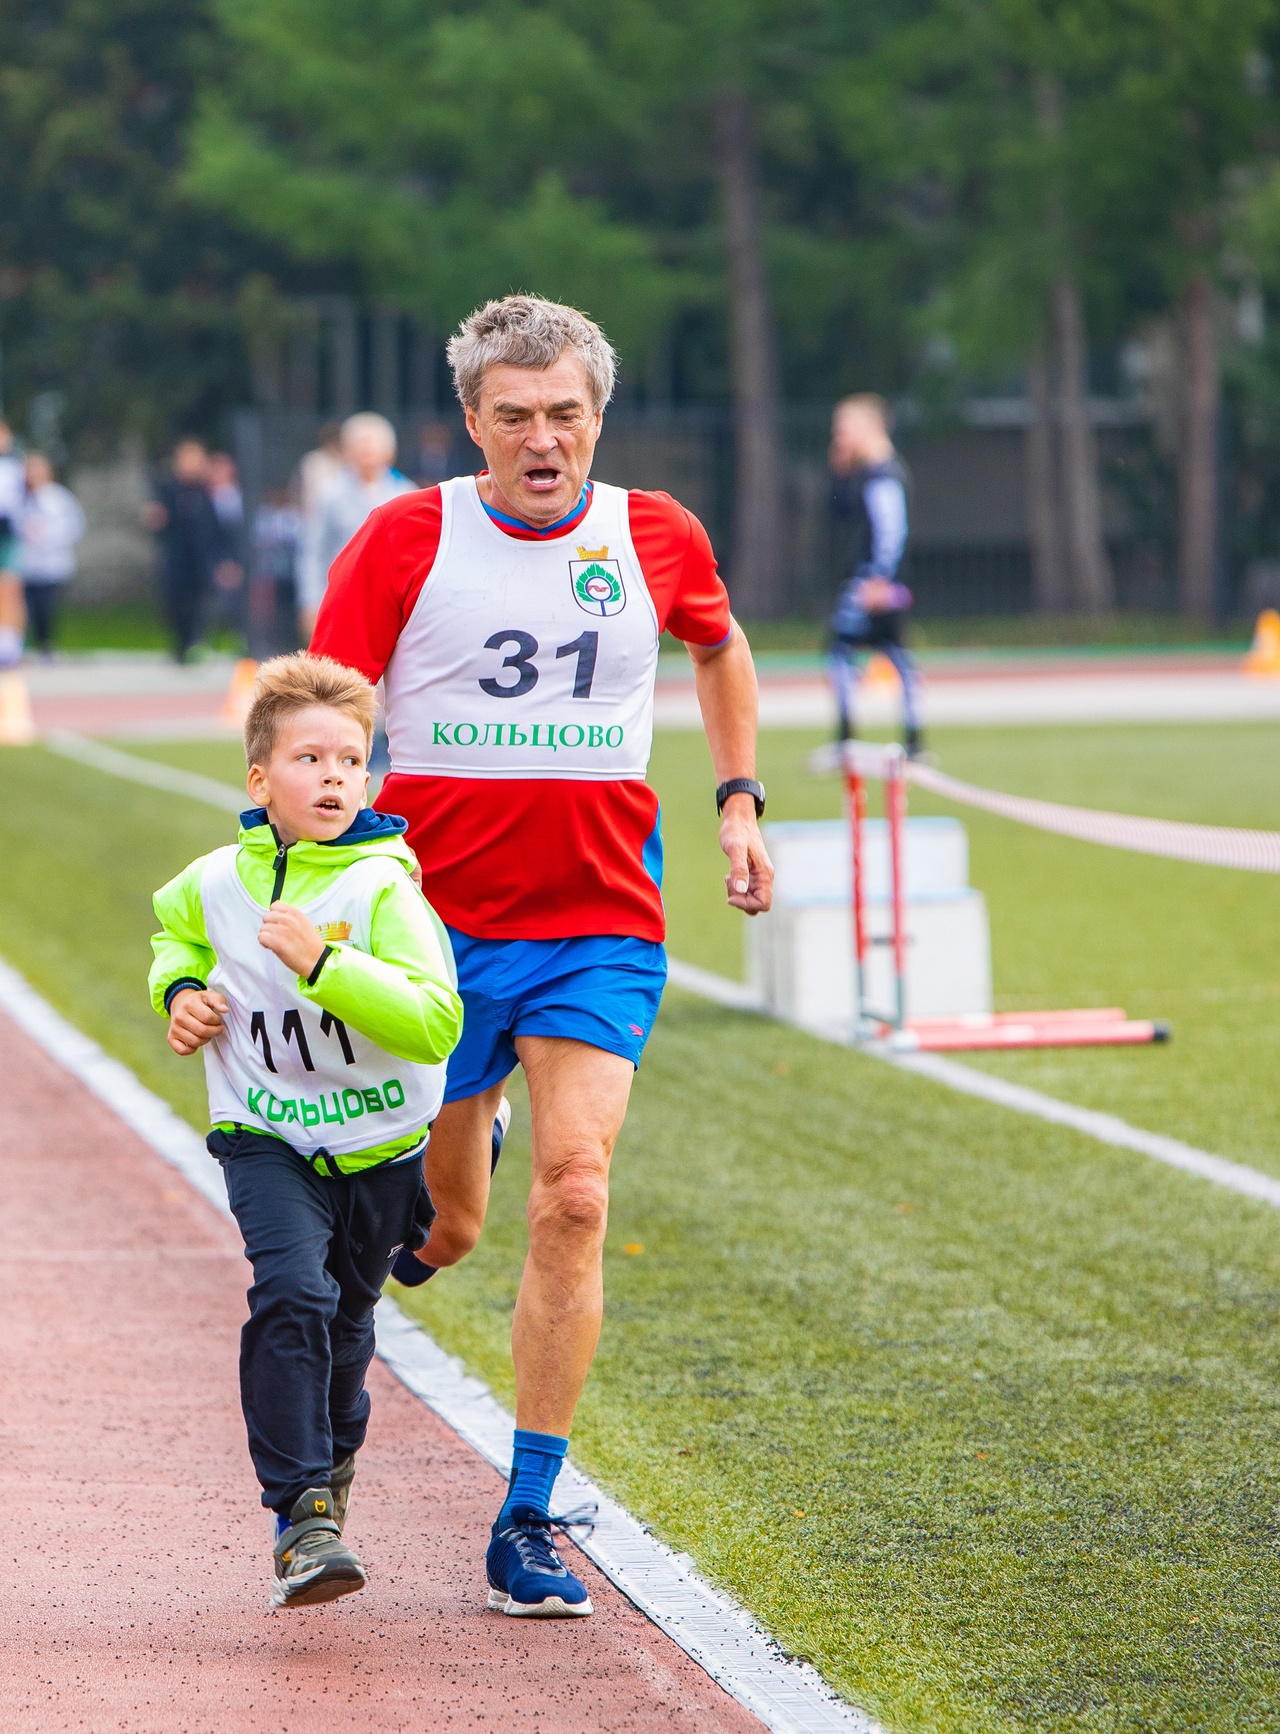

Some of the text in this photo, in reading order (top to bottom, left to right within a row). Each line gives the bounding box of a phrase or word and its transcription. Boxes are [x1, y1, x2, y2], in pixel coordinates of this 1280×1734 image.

[478, 629, 600, 699] 31
[431, 721, 625, 752] КОЛЬЦОВО
[250, 1008, 356, 1075] 111
[247, 1078, 406, 1128] КОЛЬЦОВО
